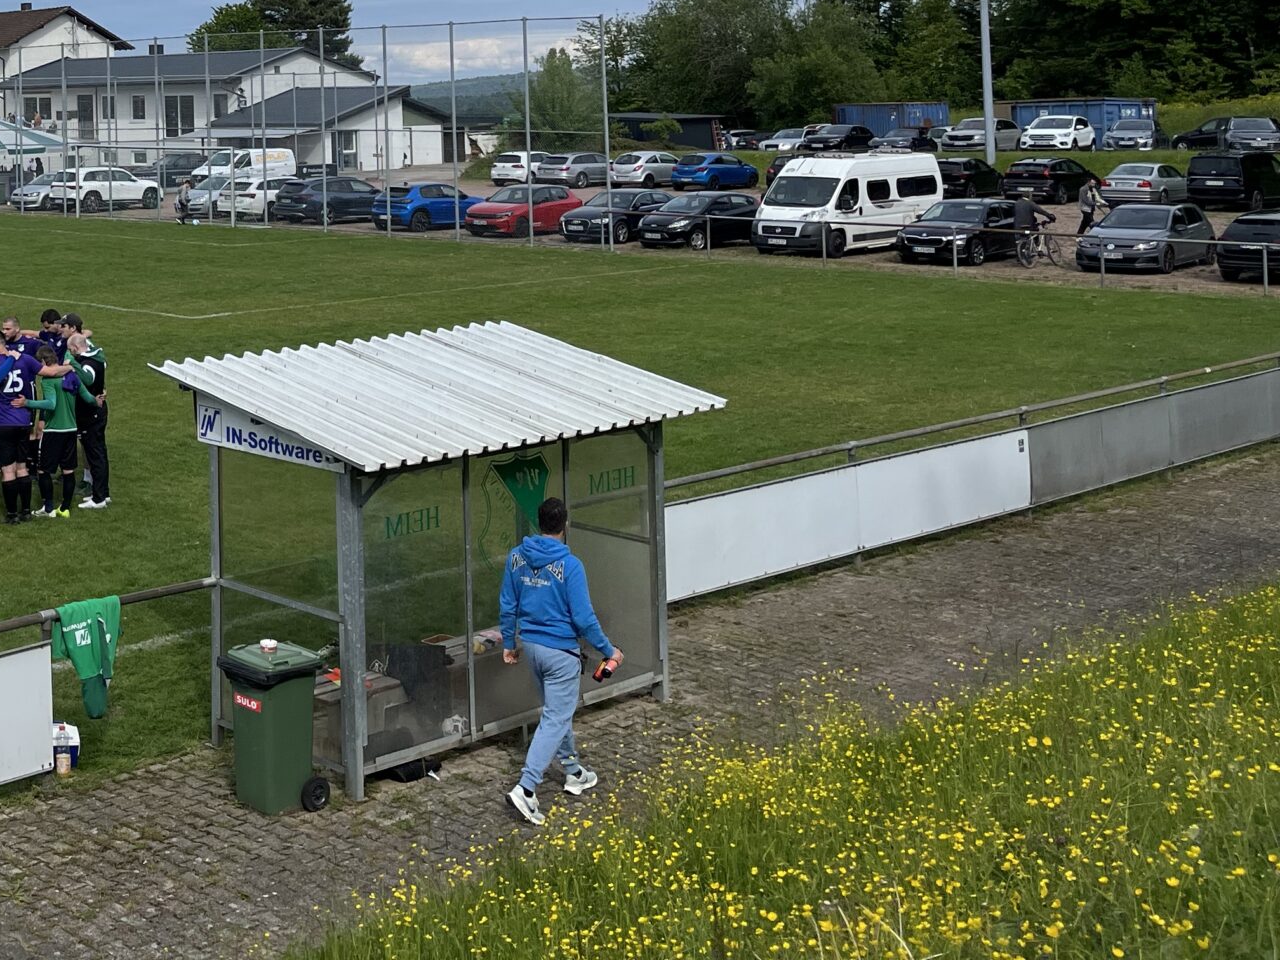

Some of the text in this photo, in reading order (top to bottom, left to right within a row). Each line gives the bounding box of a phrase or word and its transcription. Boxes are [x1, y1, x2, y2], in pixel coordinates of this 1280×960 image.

[3, 369, 24, 393] 25
[226, 426, 323, 464] IN-Software
[236, 695, 257, 710] SULO
